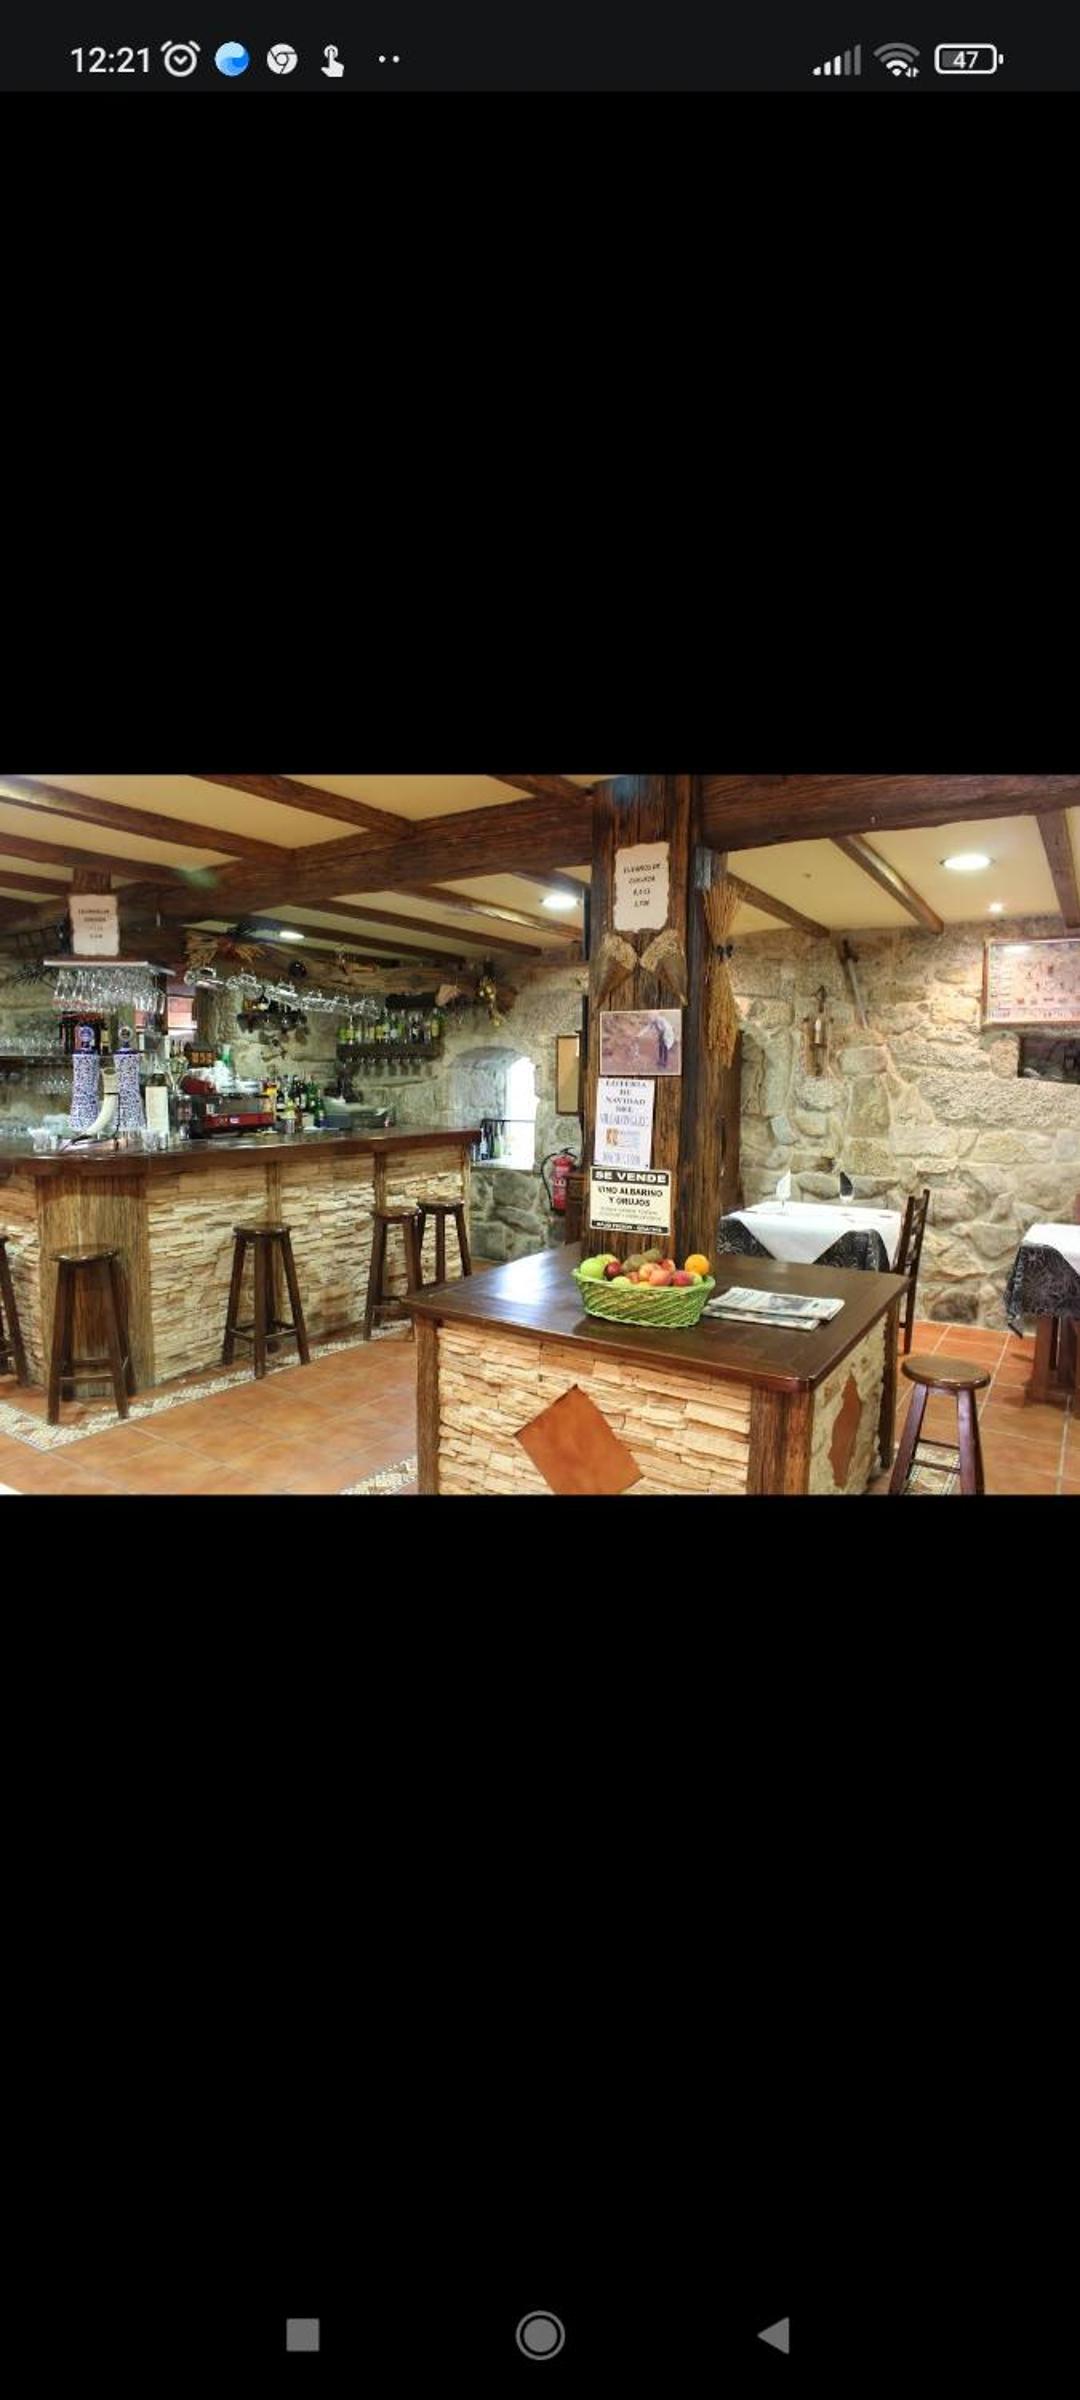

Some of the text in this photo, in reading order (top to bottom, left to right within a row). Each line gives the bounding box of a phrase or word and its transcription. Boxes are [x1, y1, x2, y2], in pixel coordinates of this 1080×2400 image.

[606, 1096, 646, 1105] NAVIDAD
[595, 1170, 667, 1183] SE VENDE
[598, 1186, 618, 1194] VINO
